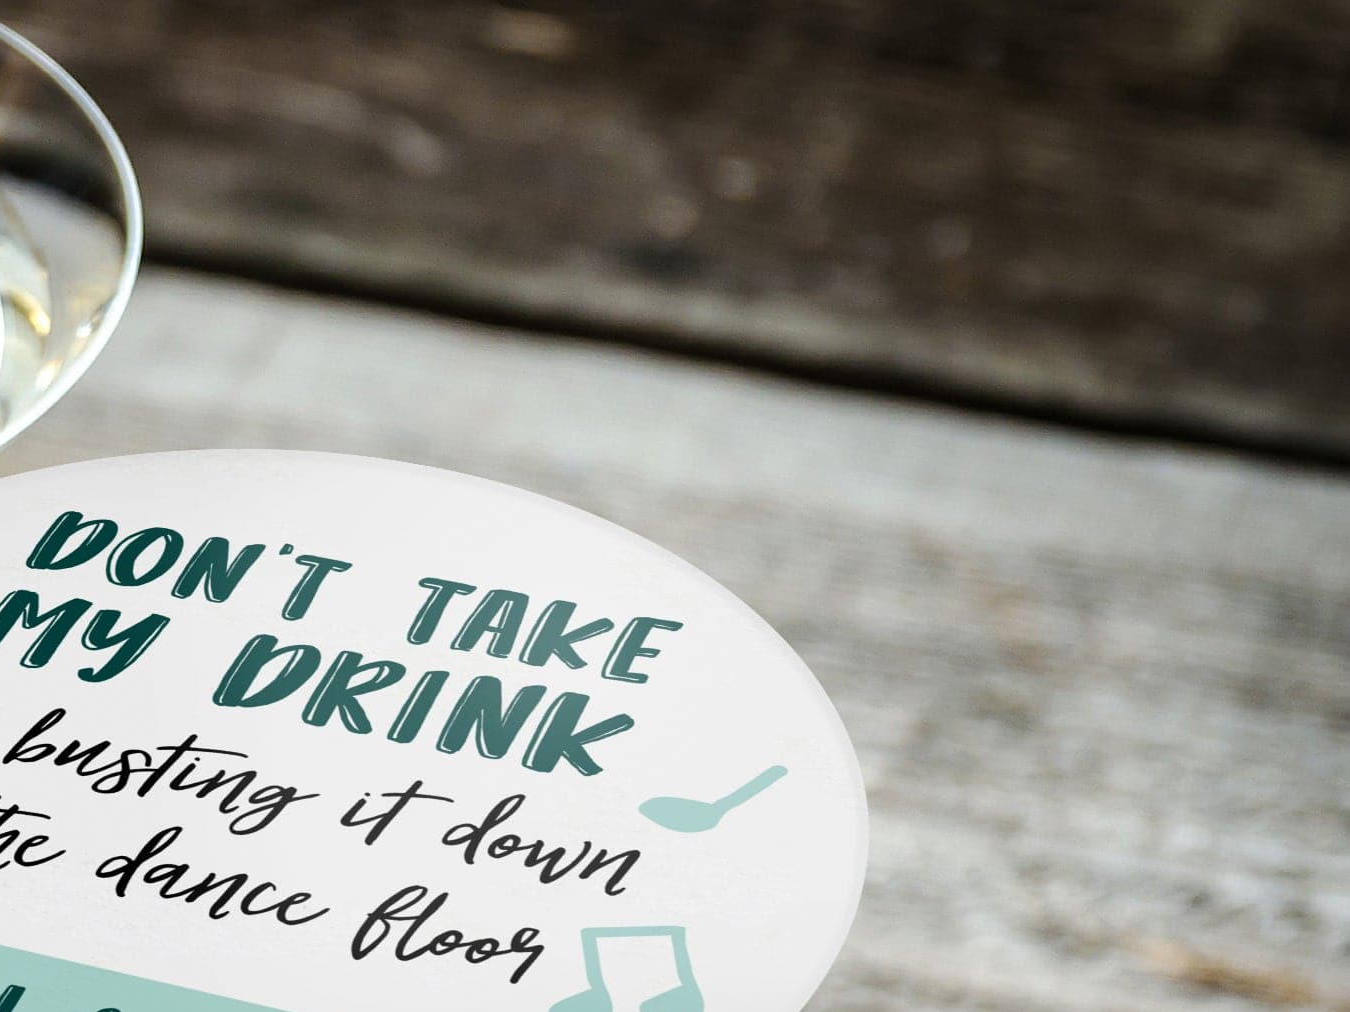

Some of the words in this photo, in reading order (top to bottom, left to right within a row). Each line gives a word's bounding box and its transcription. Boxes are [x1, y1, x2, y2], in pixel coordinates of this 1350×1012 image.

[24, 509, 353, 621] DON'T
[407, 576, 684, 684] TAKE
[212, 633, 635, 778] DRINK
[1, 706, 321, 836] busting
[340, 779, 455, 846] it
[441, 792, 642, 898] down
[95, 825, 331, 926] dance
[351, 883, 546, 985] floor
